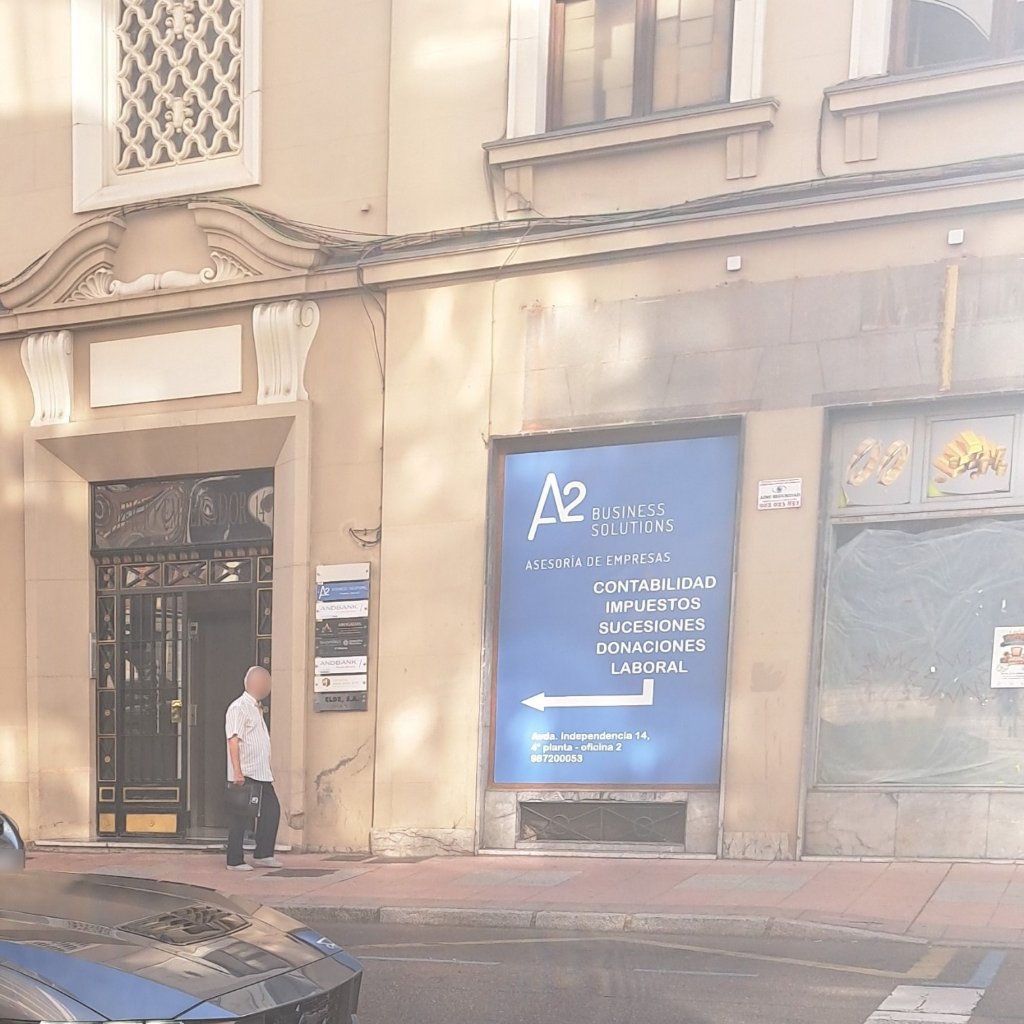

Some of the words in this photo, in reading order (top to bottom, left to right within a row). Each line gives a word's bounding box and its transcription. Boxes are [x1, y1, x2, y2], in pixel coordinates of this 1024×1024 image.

[527, 472, 588, 541] A2
[592, 503, 665, 520] BUSINESS
[591, 520, 674, 536] SOLUTIONS
[524, 554, 583, 571] ASESORÍA
[586, 555, 603, 567] DE
[606, 551, 672, 567] EMPRESAS
[593, 575, 717, 595] CONTABILIDAD
[605, 597, 701, 614] IMPUESTOS
[598, 617, 706, 635] SUCESIONES
[595, 638, 706, 655] DONACIONES
[610, 660, 689, 676] LABORAL
[560, 731, 633, 742] Independencia
[634, 731, 651, 741] 14,
[542, 743, 573, 753] planta
[580, 743, 614, 752] oficina
[615, 743, 623, 752] 2
